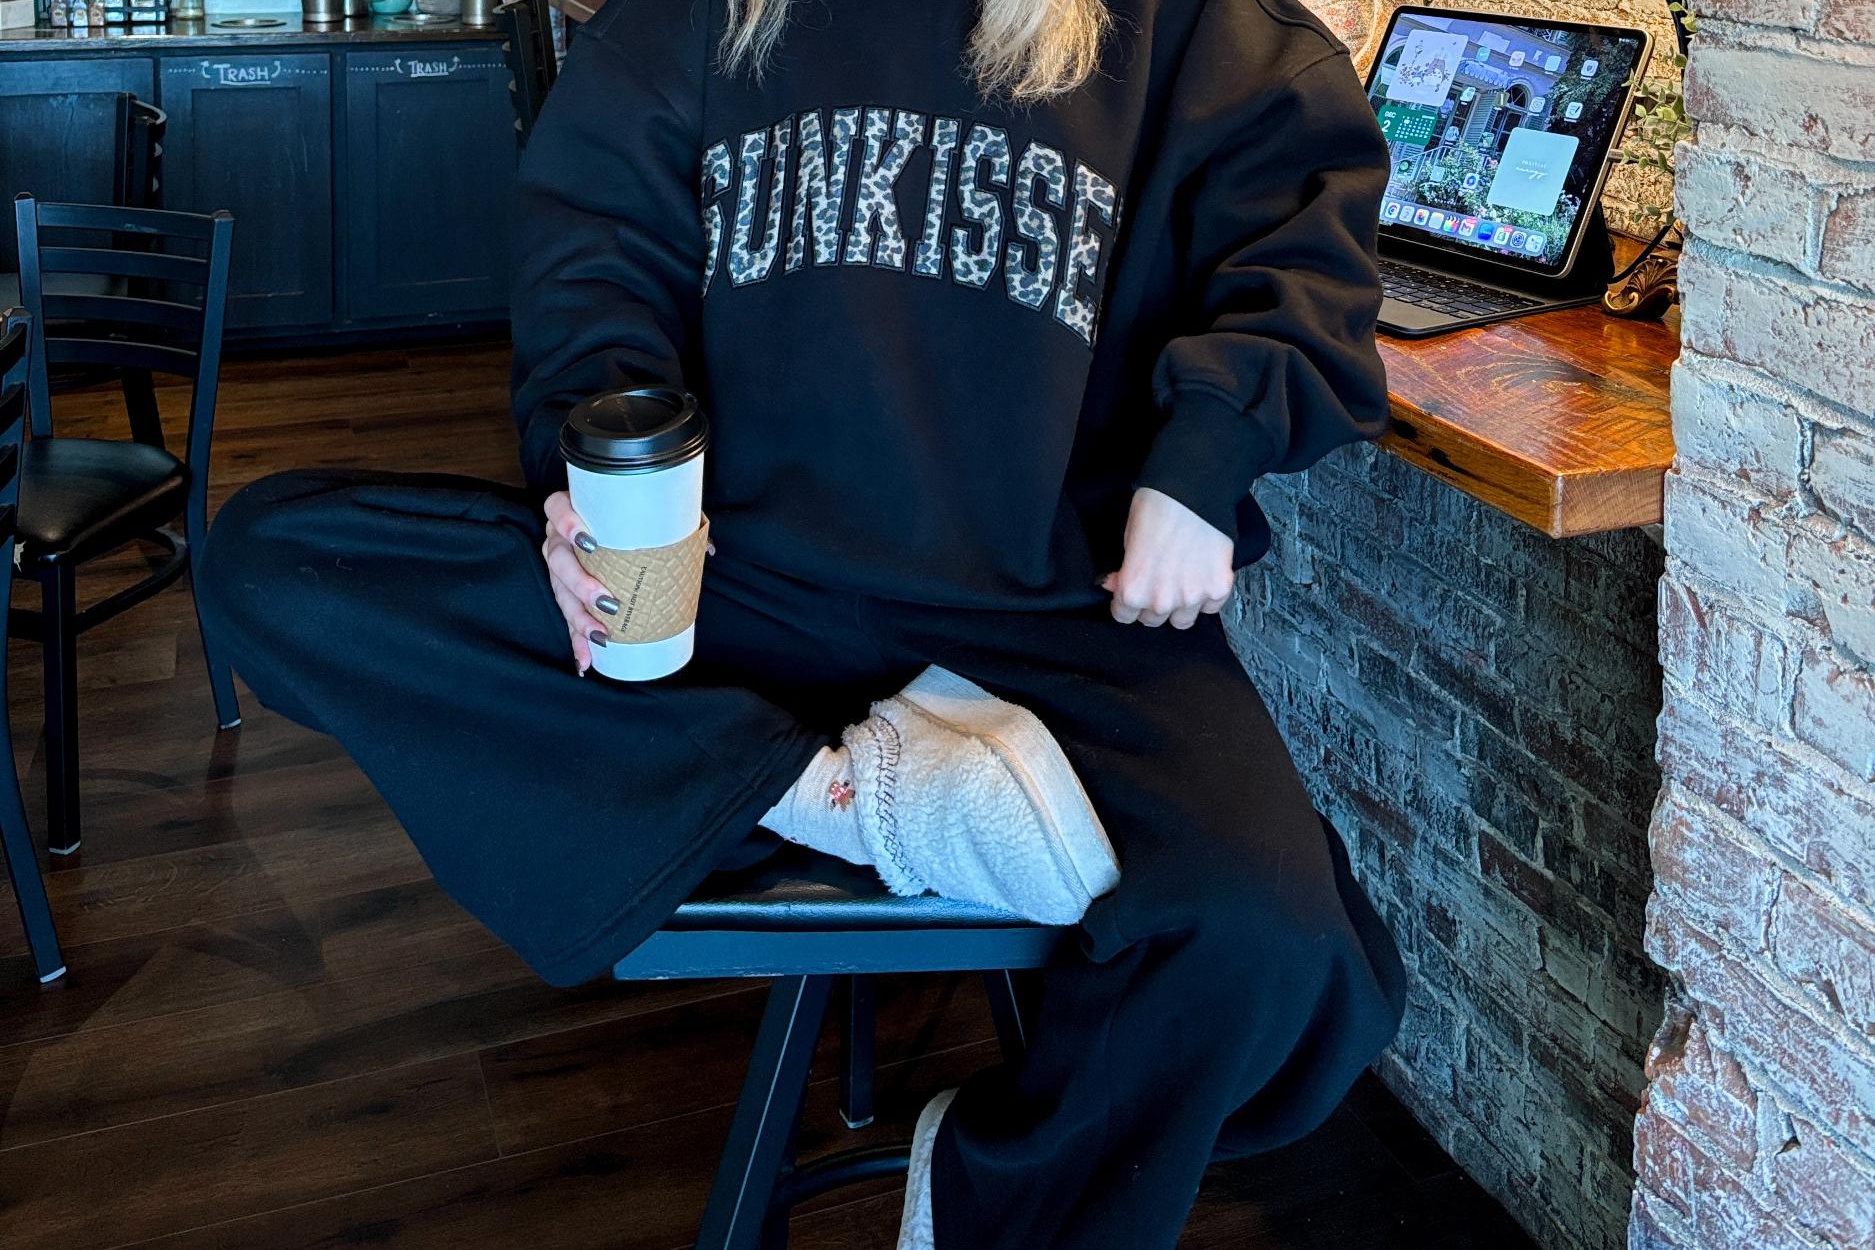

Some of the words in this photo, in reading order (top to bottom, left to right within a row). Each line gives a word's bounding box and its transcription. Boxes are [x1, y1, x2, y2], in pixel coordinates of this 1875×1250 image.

[212, 63, 270, 82] TRASH
[408, 60, 448, 75] TRASH
[1381, 119, 1391, 133] 2
[702, 107, 1123, 349] SUNKISSE
